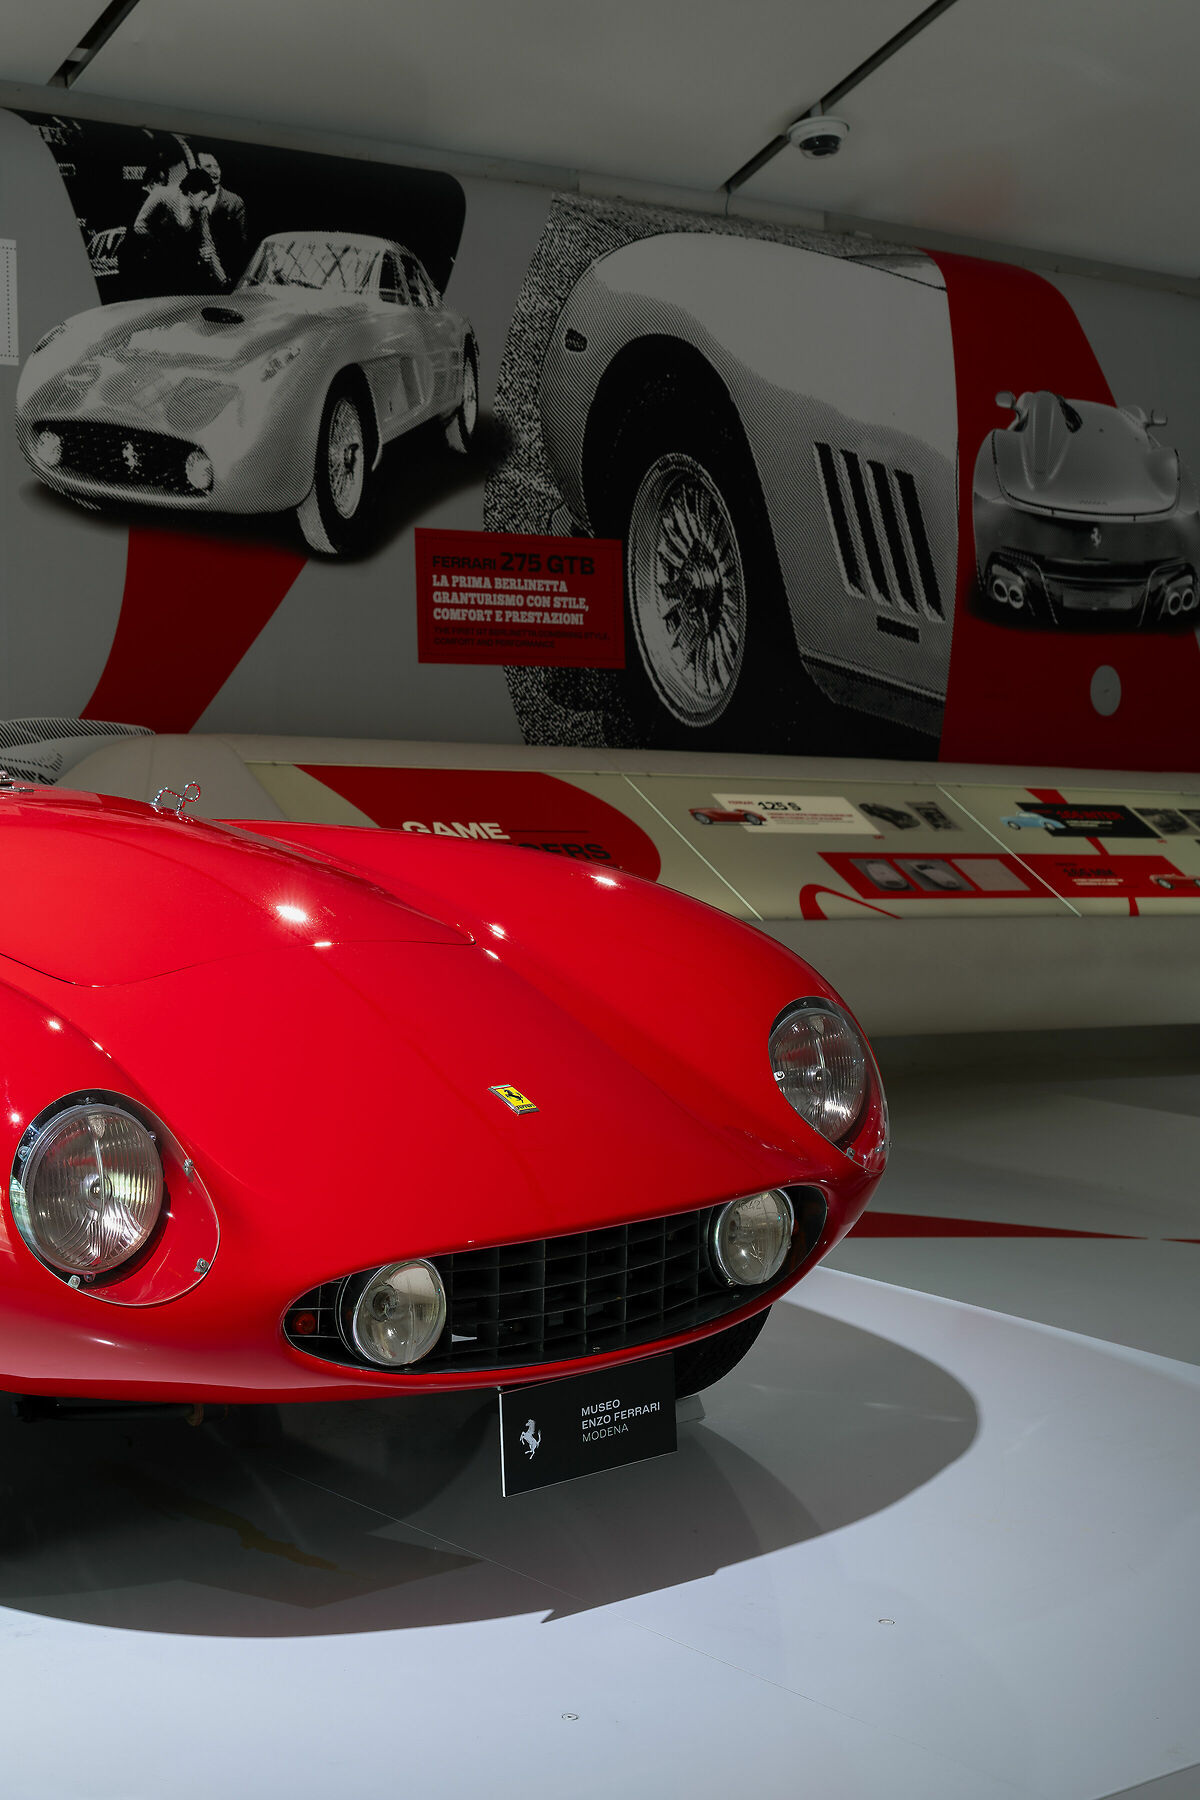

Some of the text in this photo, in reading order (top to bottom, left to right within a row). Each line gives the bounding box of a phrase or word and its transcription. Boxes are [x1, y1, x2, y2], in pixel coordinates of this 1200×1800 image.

[432, 552, 595, 575] FERRARI 275 GTB
[432, 574, 568, 593] LA PRIMA BERLINETTA
[433, 591, 589, 612] GRANTURISMO CON STILE,
[433, 608, 584, 626] COMFORT E PRESTAZIONI
[757, 802, 788, 811] 125
[581, 1399, 621, 1417] MUSEO
[581, 1402, 661, 1430] ENZO FERRARI
[582, 1423, 629, 1443] MODENA
